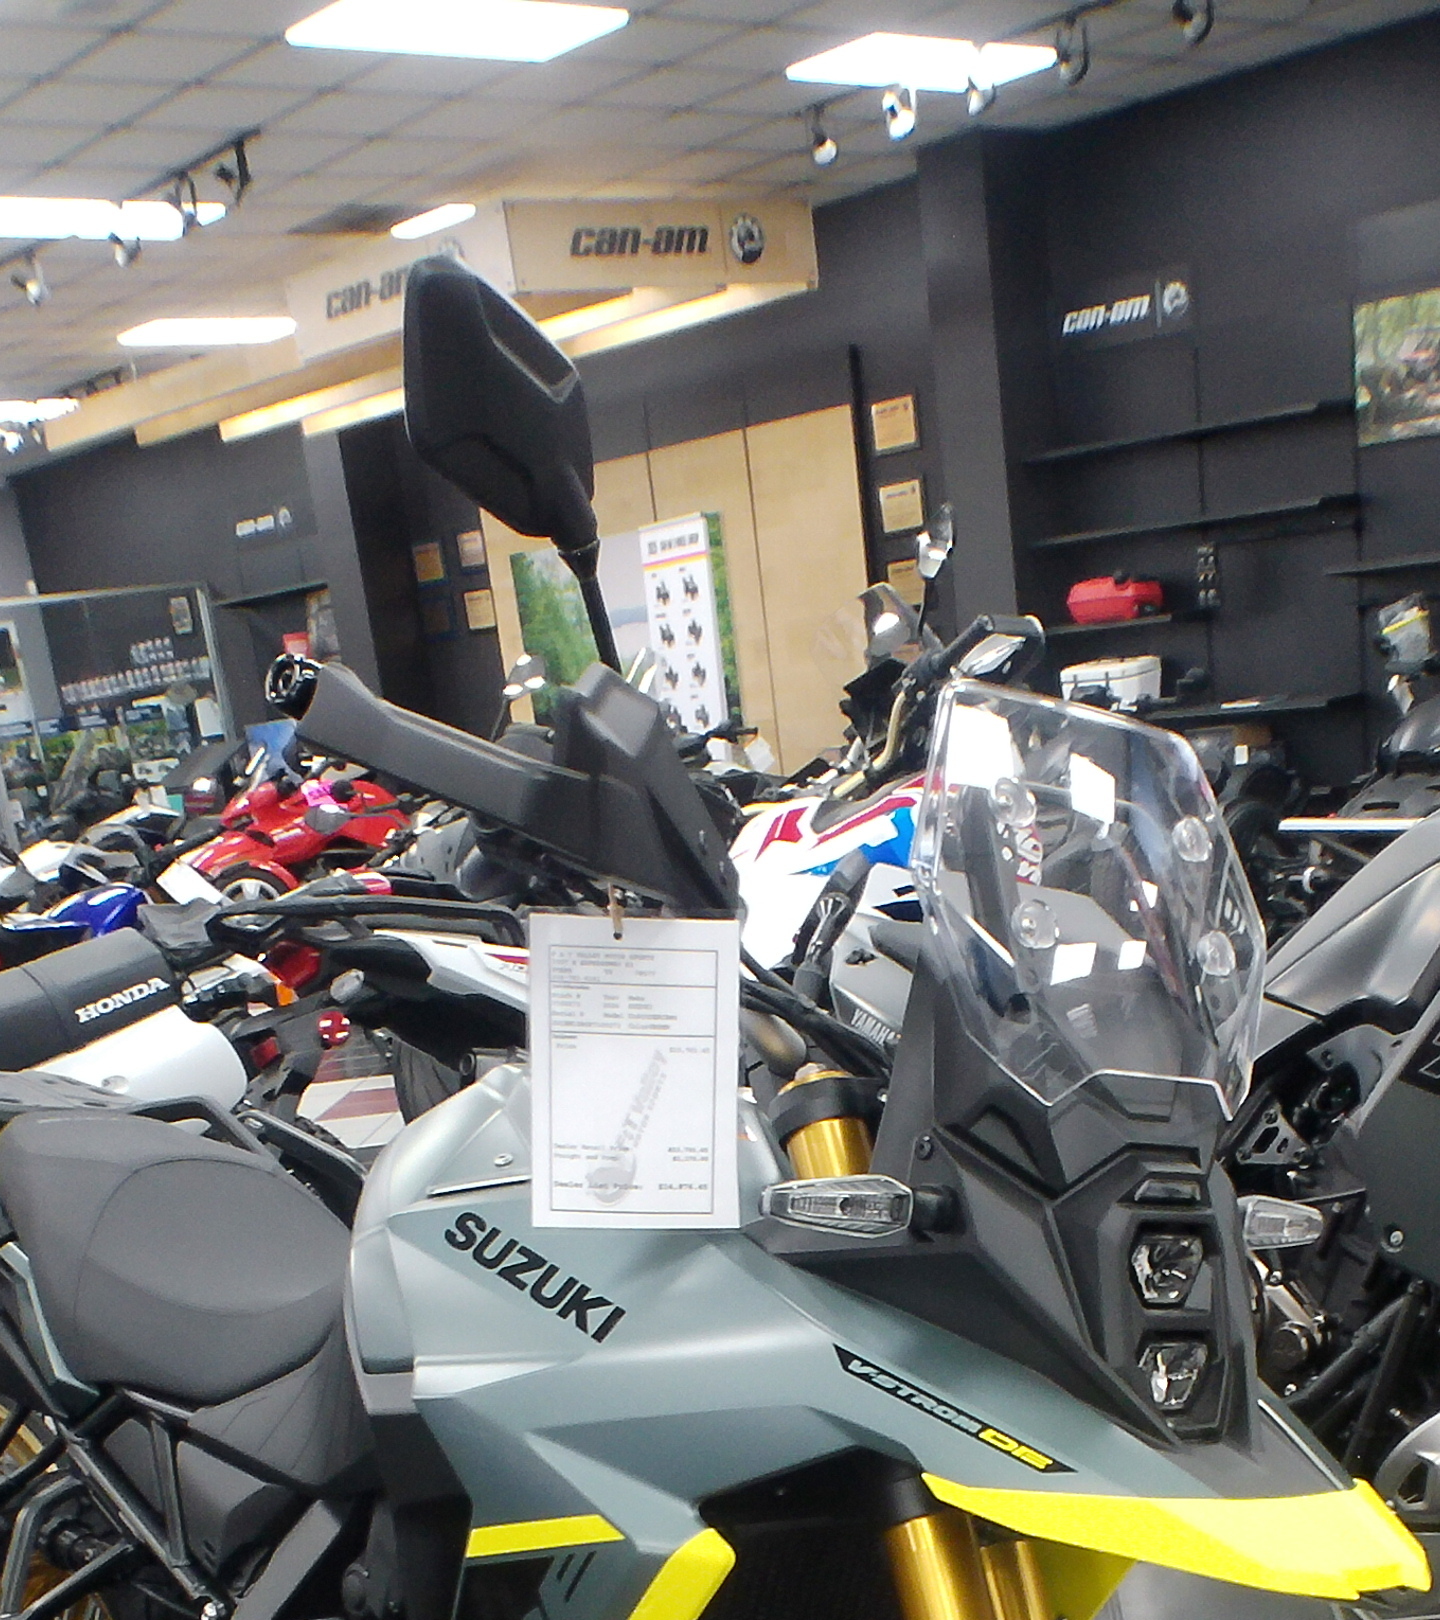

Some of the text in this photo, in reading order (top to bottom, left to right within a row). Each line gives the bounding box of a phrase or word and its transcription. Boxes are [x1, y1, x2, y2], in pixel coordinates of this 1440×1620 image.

[570, 225, 709, 257] can-am
[1062, 294, 1151, 337] can-am
[74, 977, 171, 1024] HONDA
[444, 1211, 627, 1344] SUZUKI
[847, 1358, 1055, 1471] V-STROM DE
